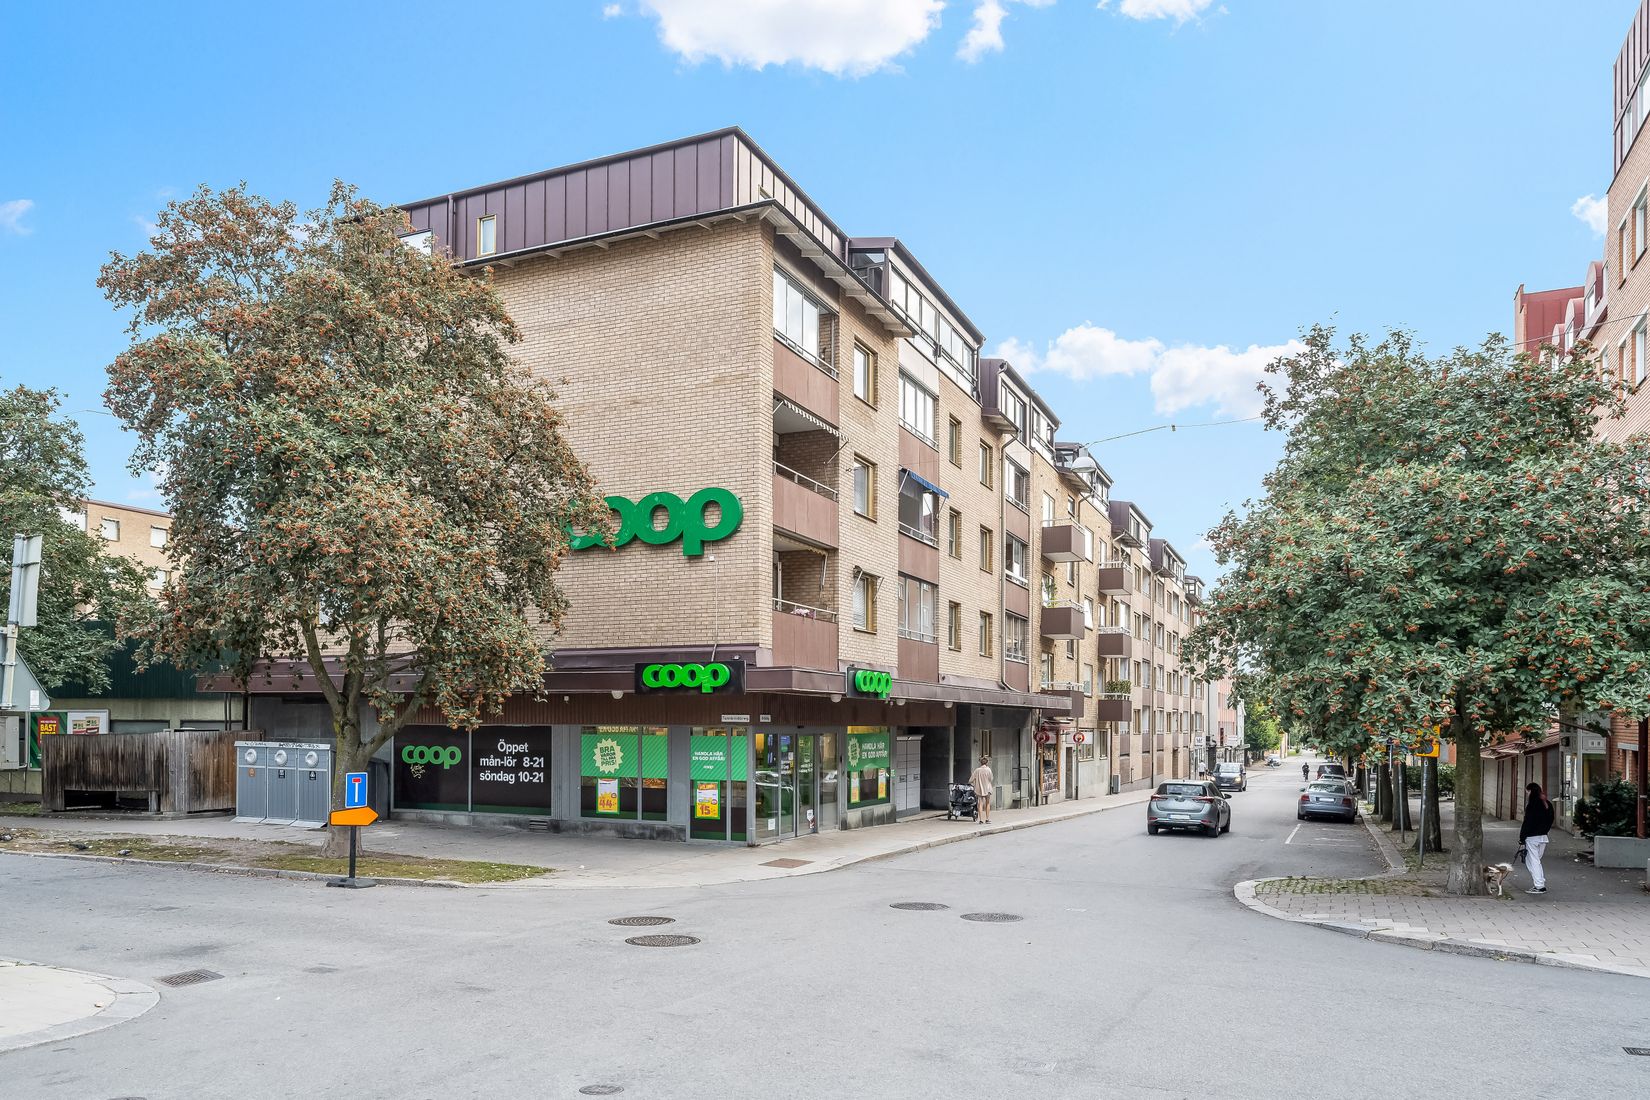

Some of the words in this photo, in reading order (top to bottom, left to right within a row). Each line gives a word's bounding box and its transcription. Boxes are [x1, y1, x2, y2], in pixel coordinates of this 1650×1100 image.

[643, 663, 730, 693] coop
[855, 670, 892, 699] coop
[497, 739, 529, 754] Öppet
[402, 745, 462, 769] coop
[480, 755, 517, 767] mån-lör
[522, 757, 544, 768] 8-21
[479, 771, 515, 784] söndag
[518, 771, 544, 783] 10-21
